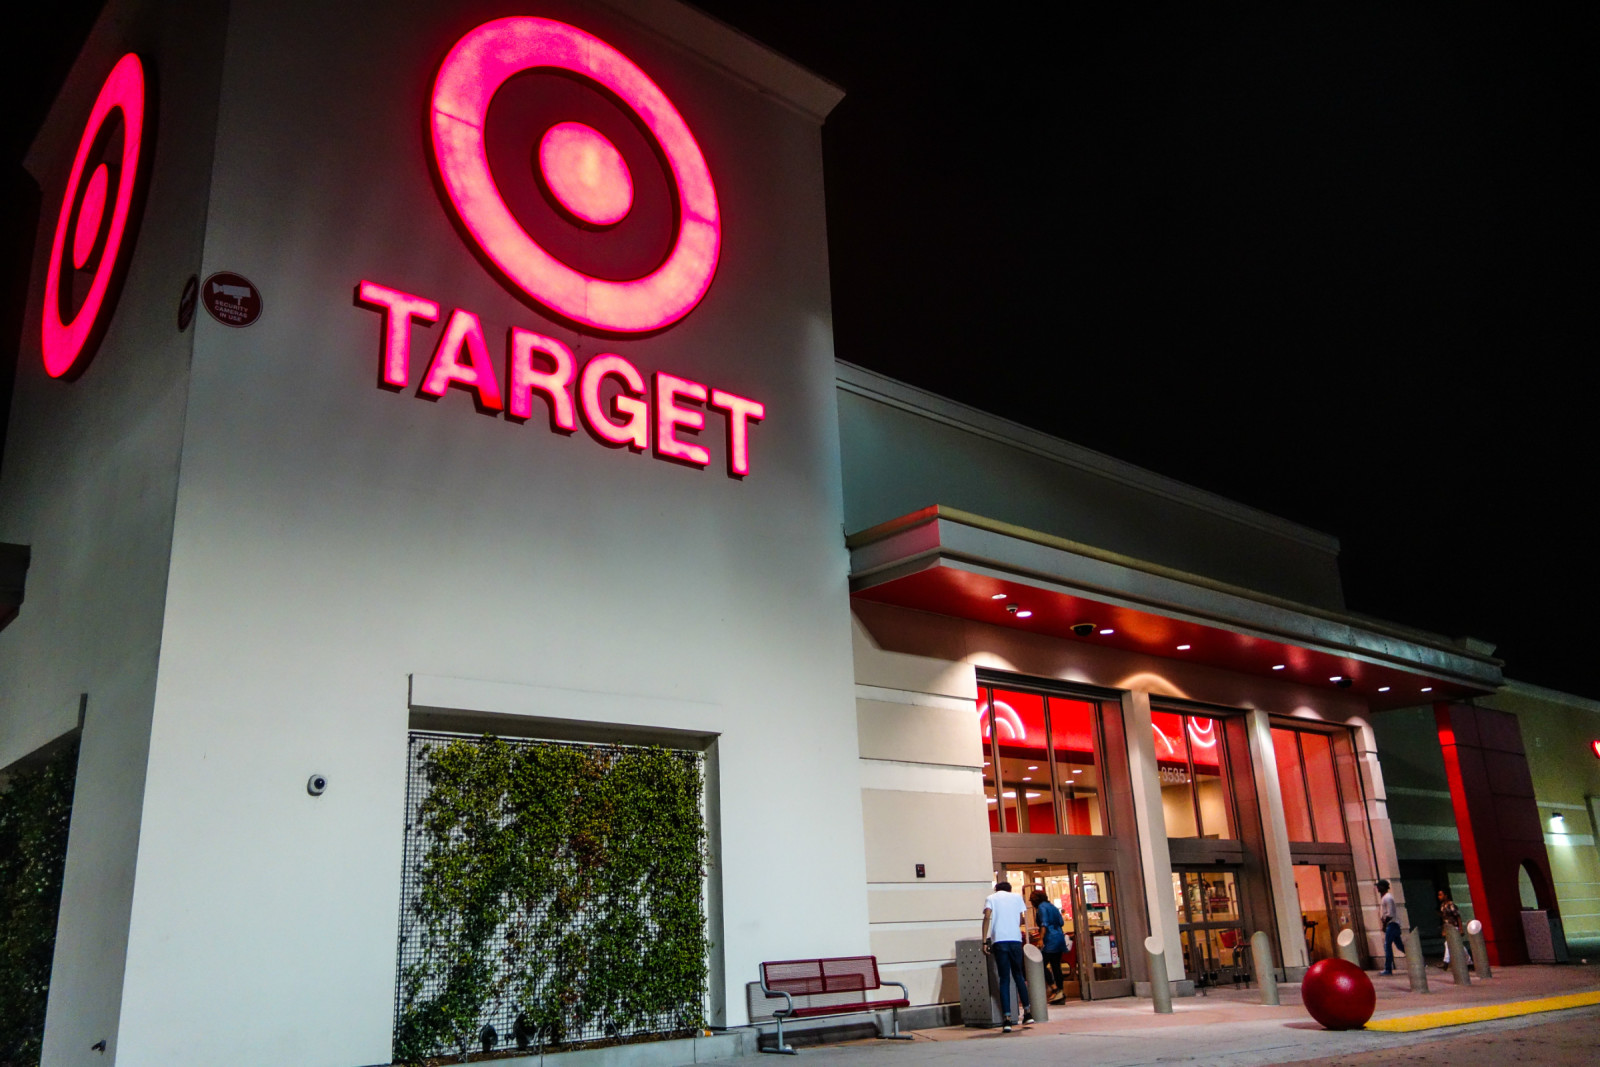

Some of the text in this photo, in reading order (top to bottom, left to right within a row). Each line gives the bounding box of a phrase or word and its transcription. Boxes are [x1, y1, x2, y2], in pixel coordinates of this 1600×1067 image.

[214, 305, 248, 318] CAMERAS
[215, 300, 248, 312] SECURITY
[356, 279, 766, 479] TARGET
